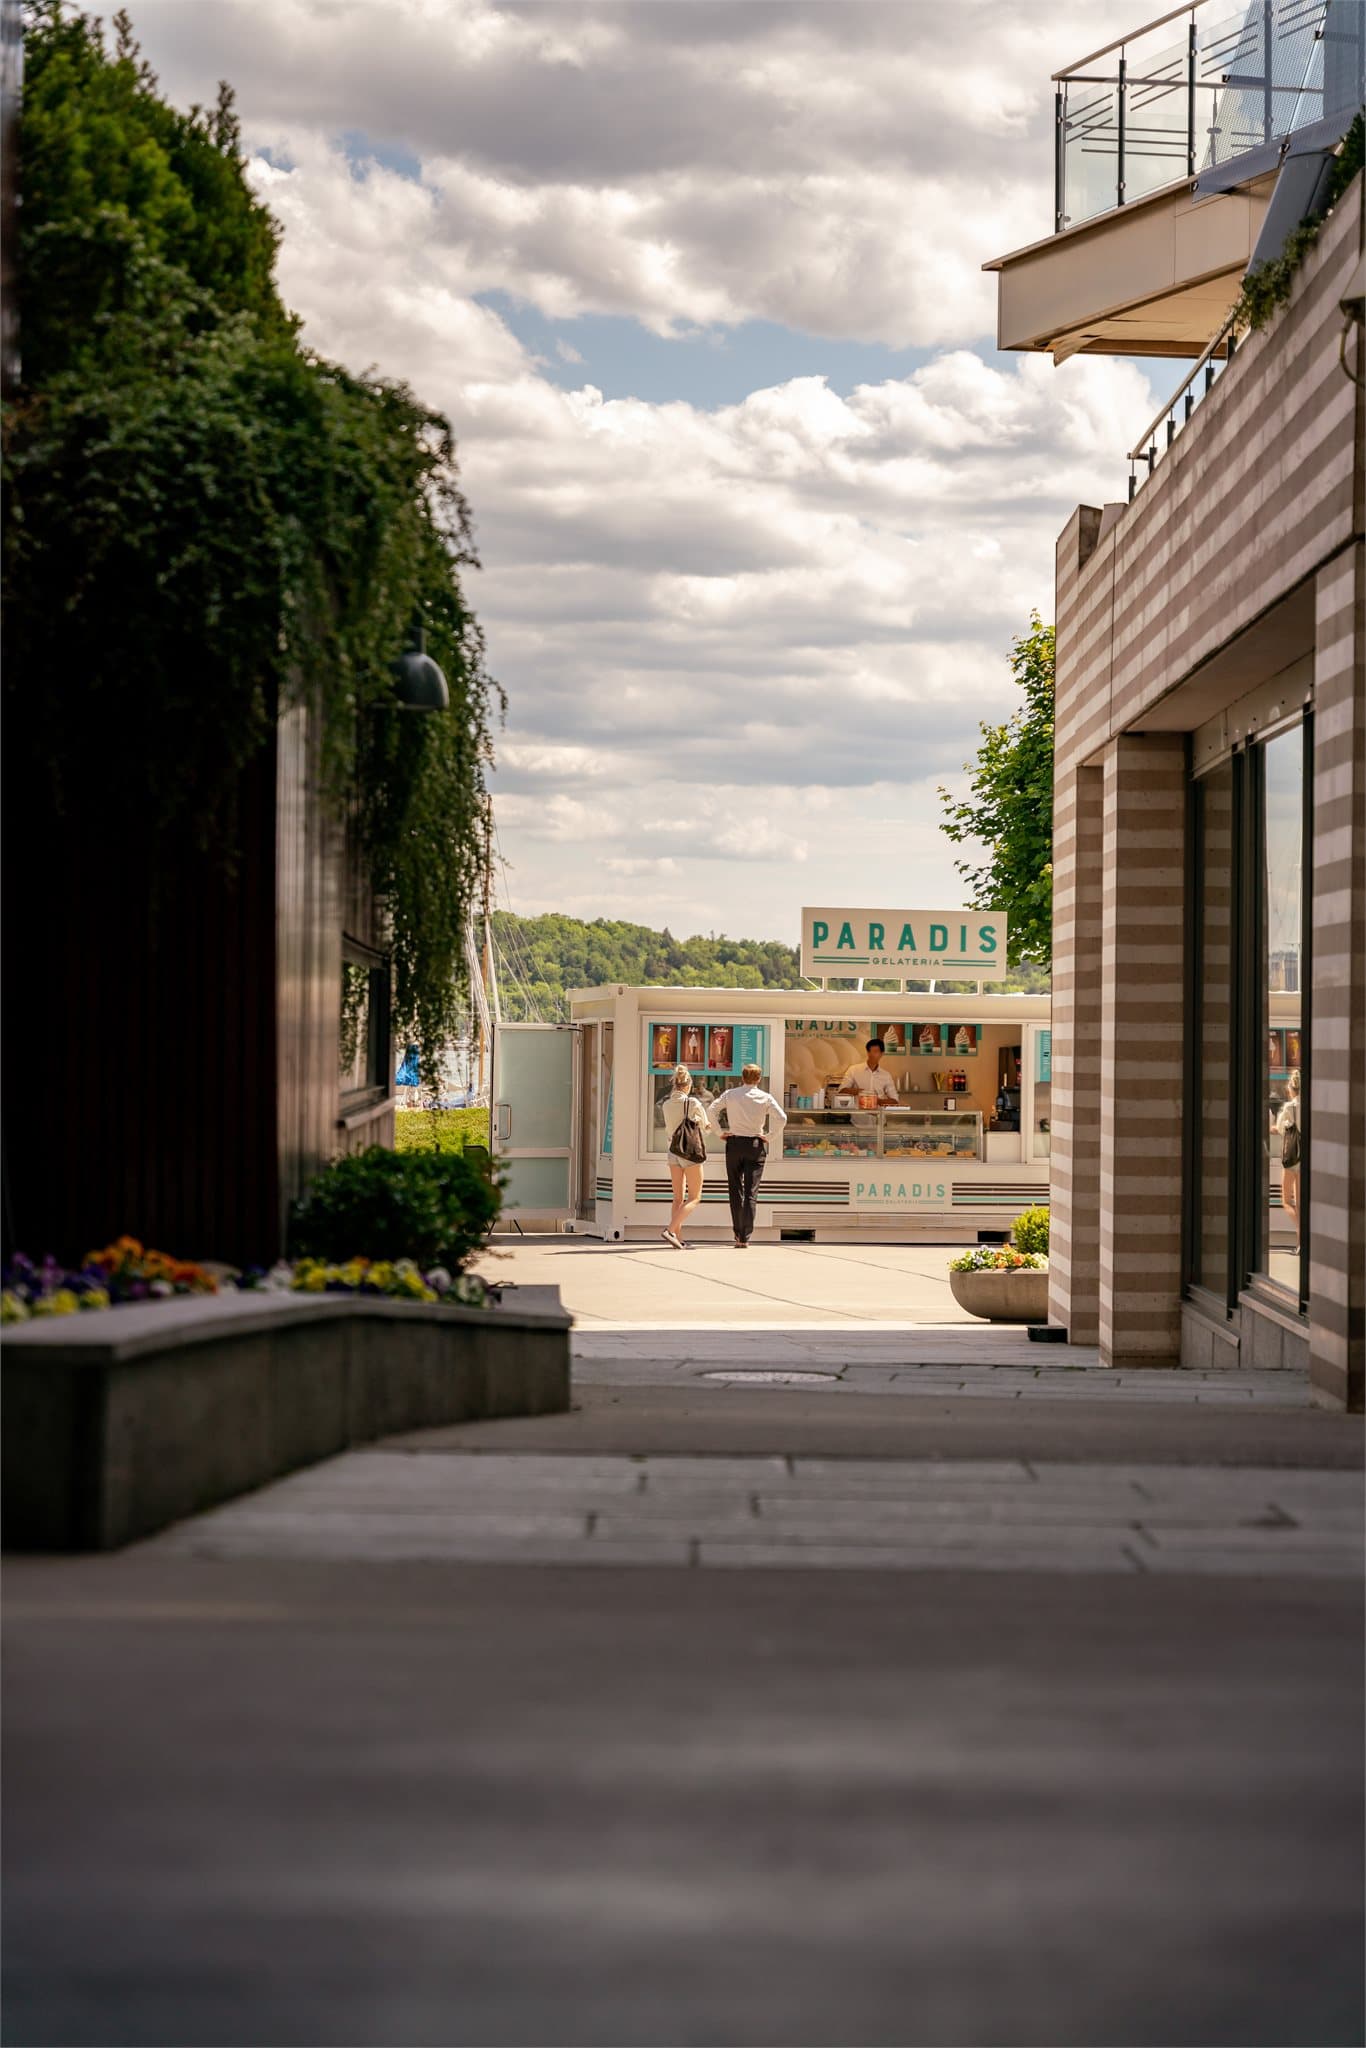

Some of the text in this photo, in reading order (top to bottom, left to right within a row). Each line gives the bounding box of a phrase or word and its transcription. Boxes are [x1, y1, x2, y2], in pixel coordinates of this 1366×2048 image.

[812, 921, 998, 954] PARADIS
[872, 957, 940, 966] GELATERIA
[856, 1183, 945, 1198] PARADIS
